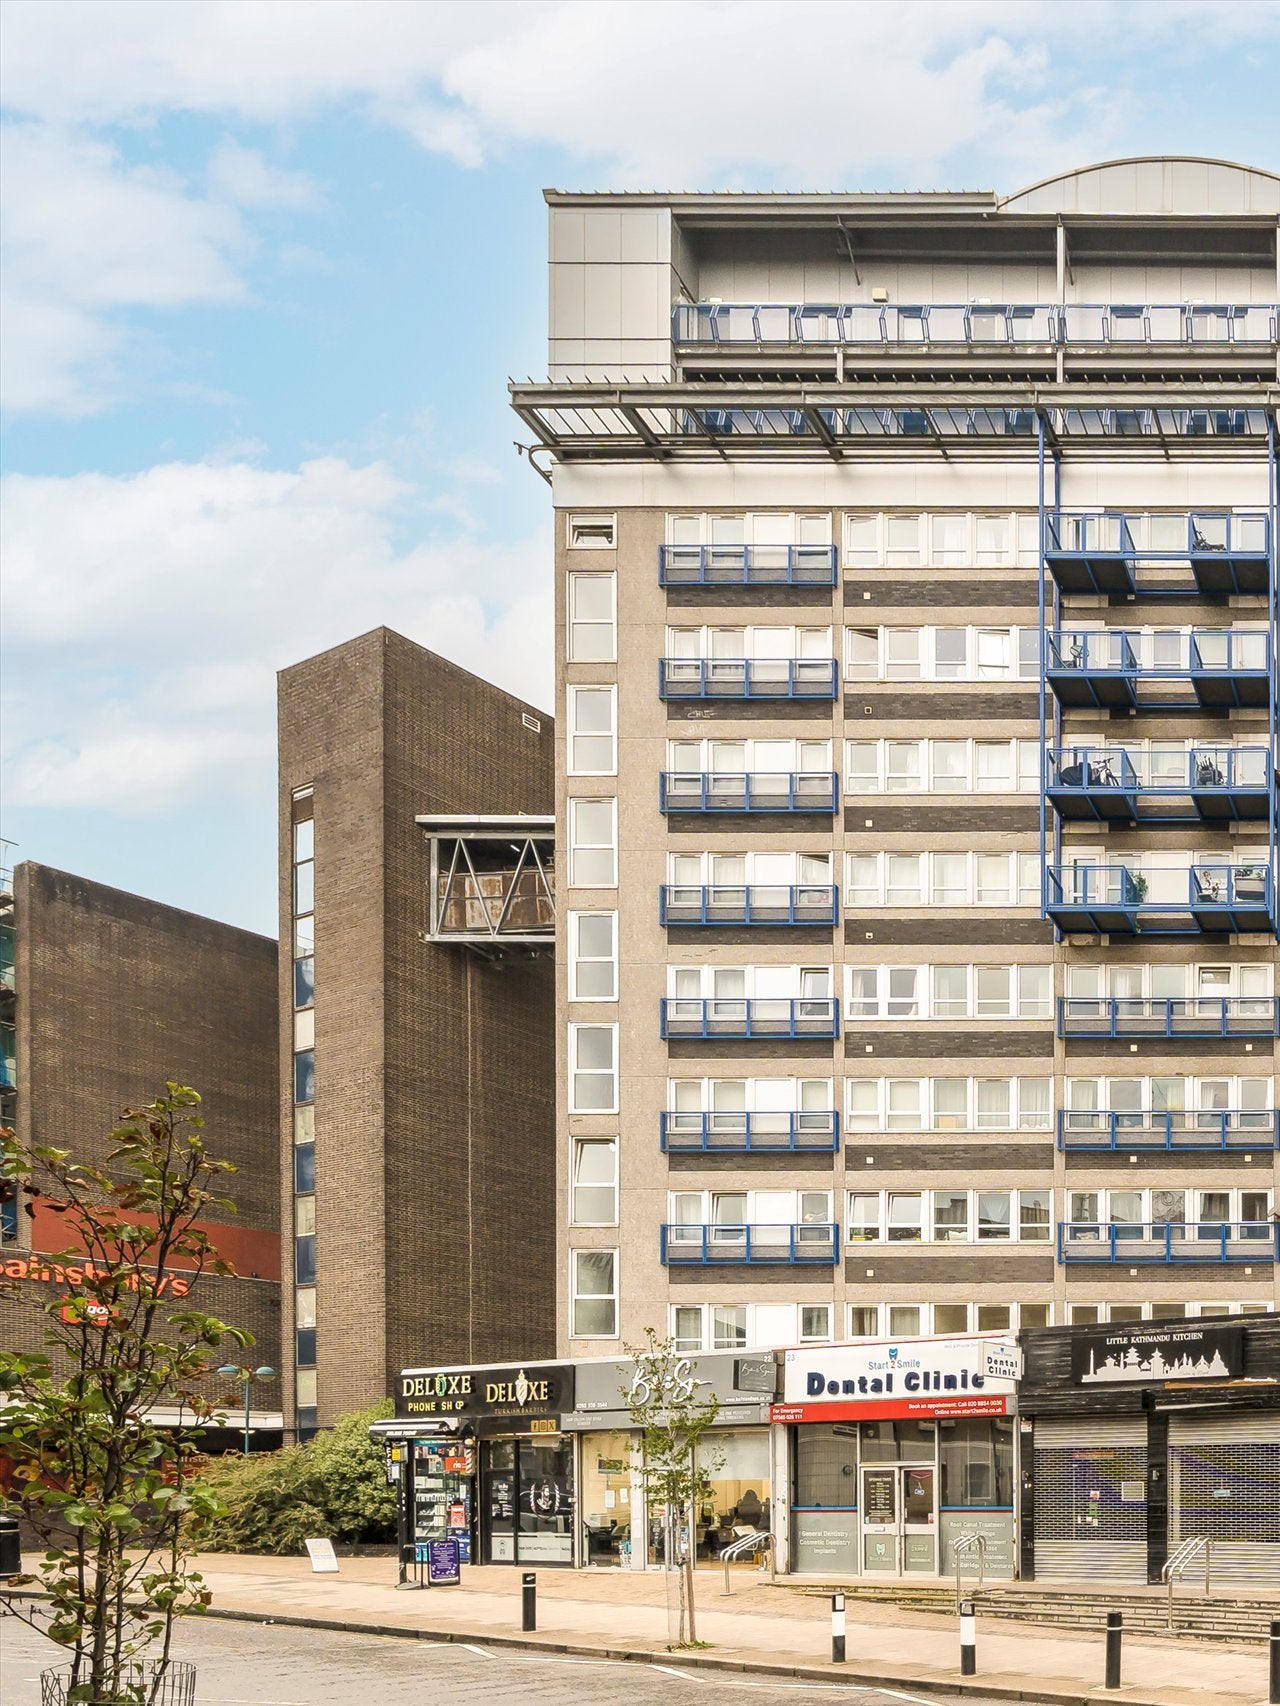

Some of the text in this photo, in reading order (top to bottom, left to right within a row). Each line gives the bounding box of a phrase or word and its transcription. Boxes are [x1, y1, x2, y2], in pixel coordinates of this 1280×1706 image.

[1106, 1332, 1203, 1345] LITTLE KATHMANDU KITCHEN
[787, 1354, 795, 1362] 23
[987, 1356, 1018, 1368] Dental
[868, 1358, 920, 1371] Start 2 Smile
[988, 1366, 1016, 1377] Clinic
[806, 1369, 985, 1396] Dental Clinic
[407, 1402, 436, 1412] PHONE
[823, 1530, 848, 1538] Dentistry
